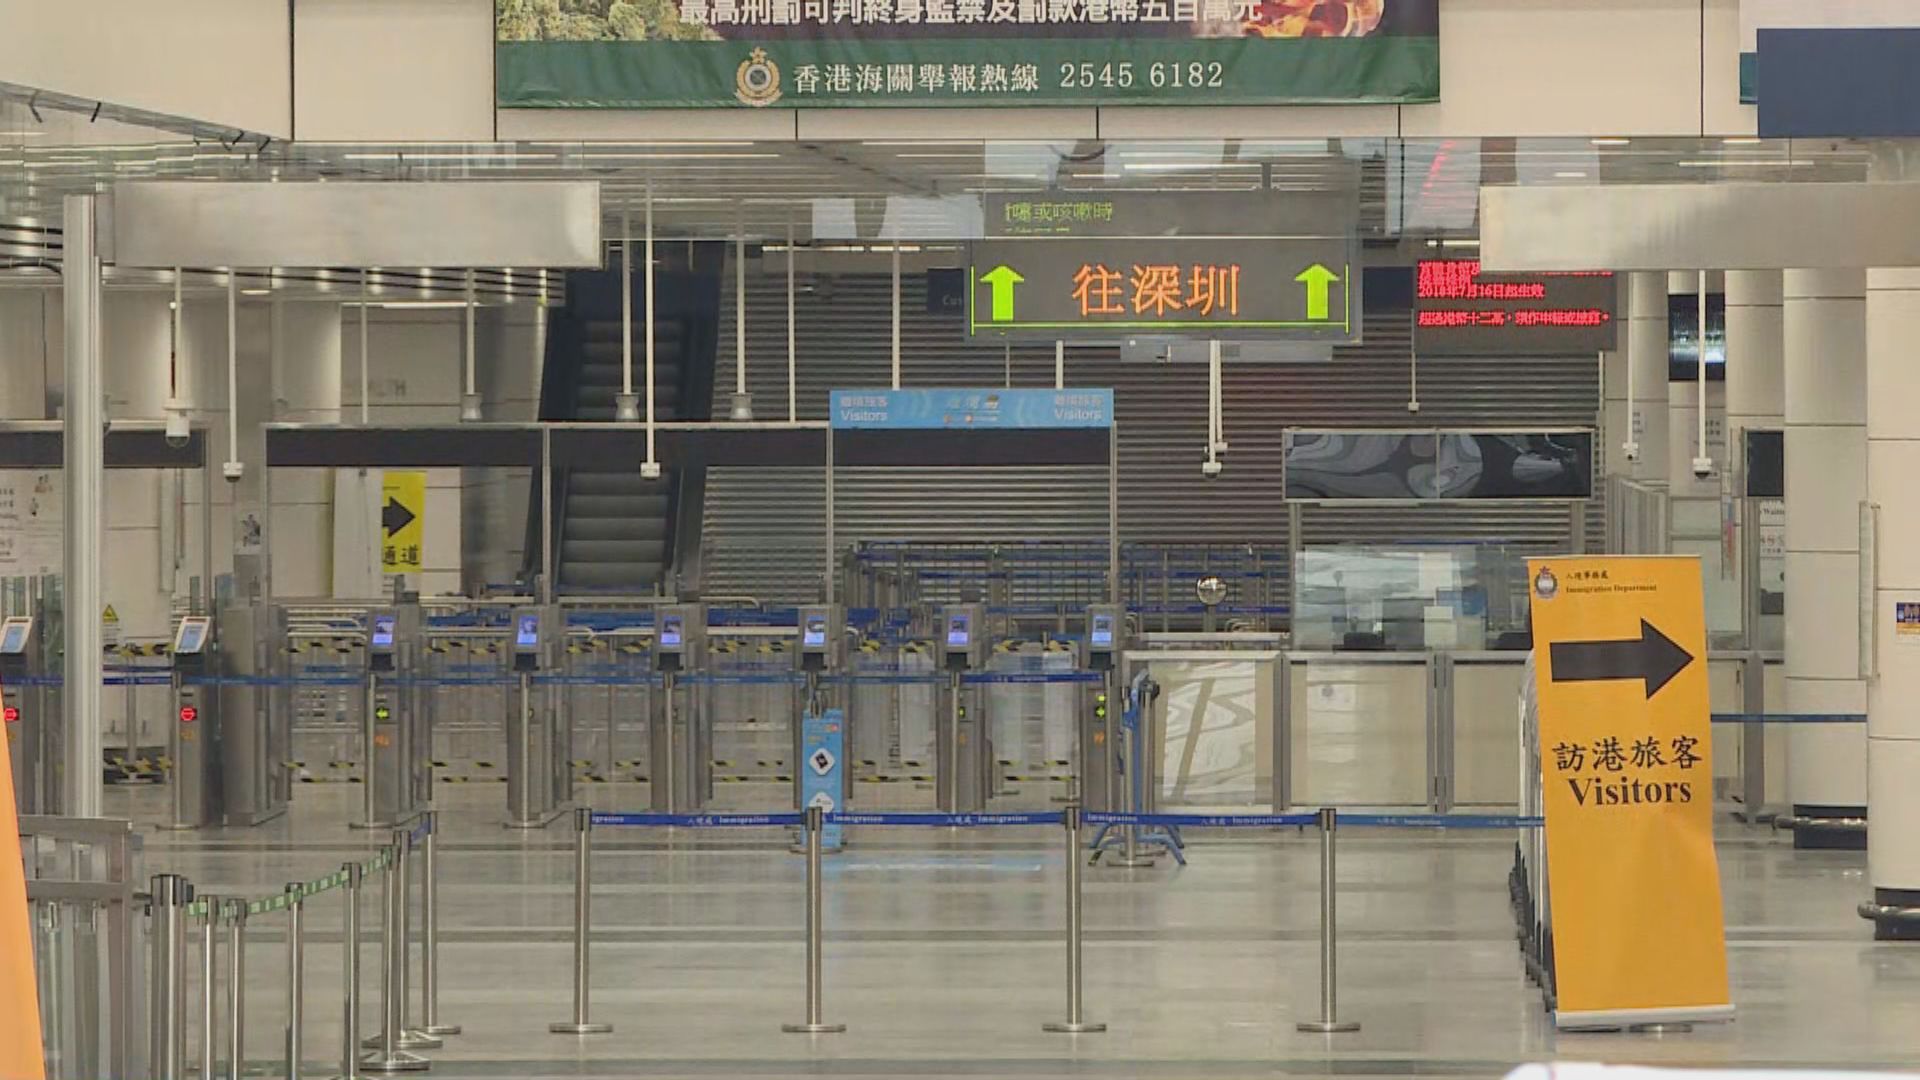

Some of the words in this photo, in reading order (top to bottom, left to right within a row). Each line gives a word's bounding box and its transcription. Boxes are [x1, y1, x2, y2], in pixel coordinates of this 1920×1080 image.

[793, 63, 1039, 93] 香港海關舉報熱線
[1060, 62, 1134, 88] 2545
[1149, 62, 1223, 88] 6182
[1071, 263, 1241, 316] 往深圳
[840, 409, 888, 421] Visitors
[1055, 408, 1103, 420] Visitors
[382, 544, 420, 566] 通道
[1552, 735, 1702, 772] 訪港旅客
[1567, 776, 1692, 806] Visitors
[719, 815, 770, 825] Immigration
[833, 814, 884, 823] Immigration
[978, 814, 1029, 823] Immigration
[1087, 813, 1138, 822] Immigration
[1232, 815, 1283, 824] Immigration
